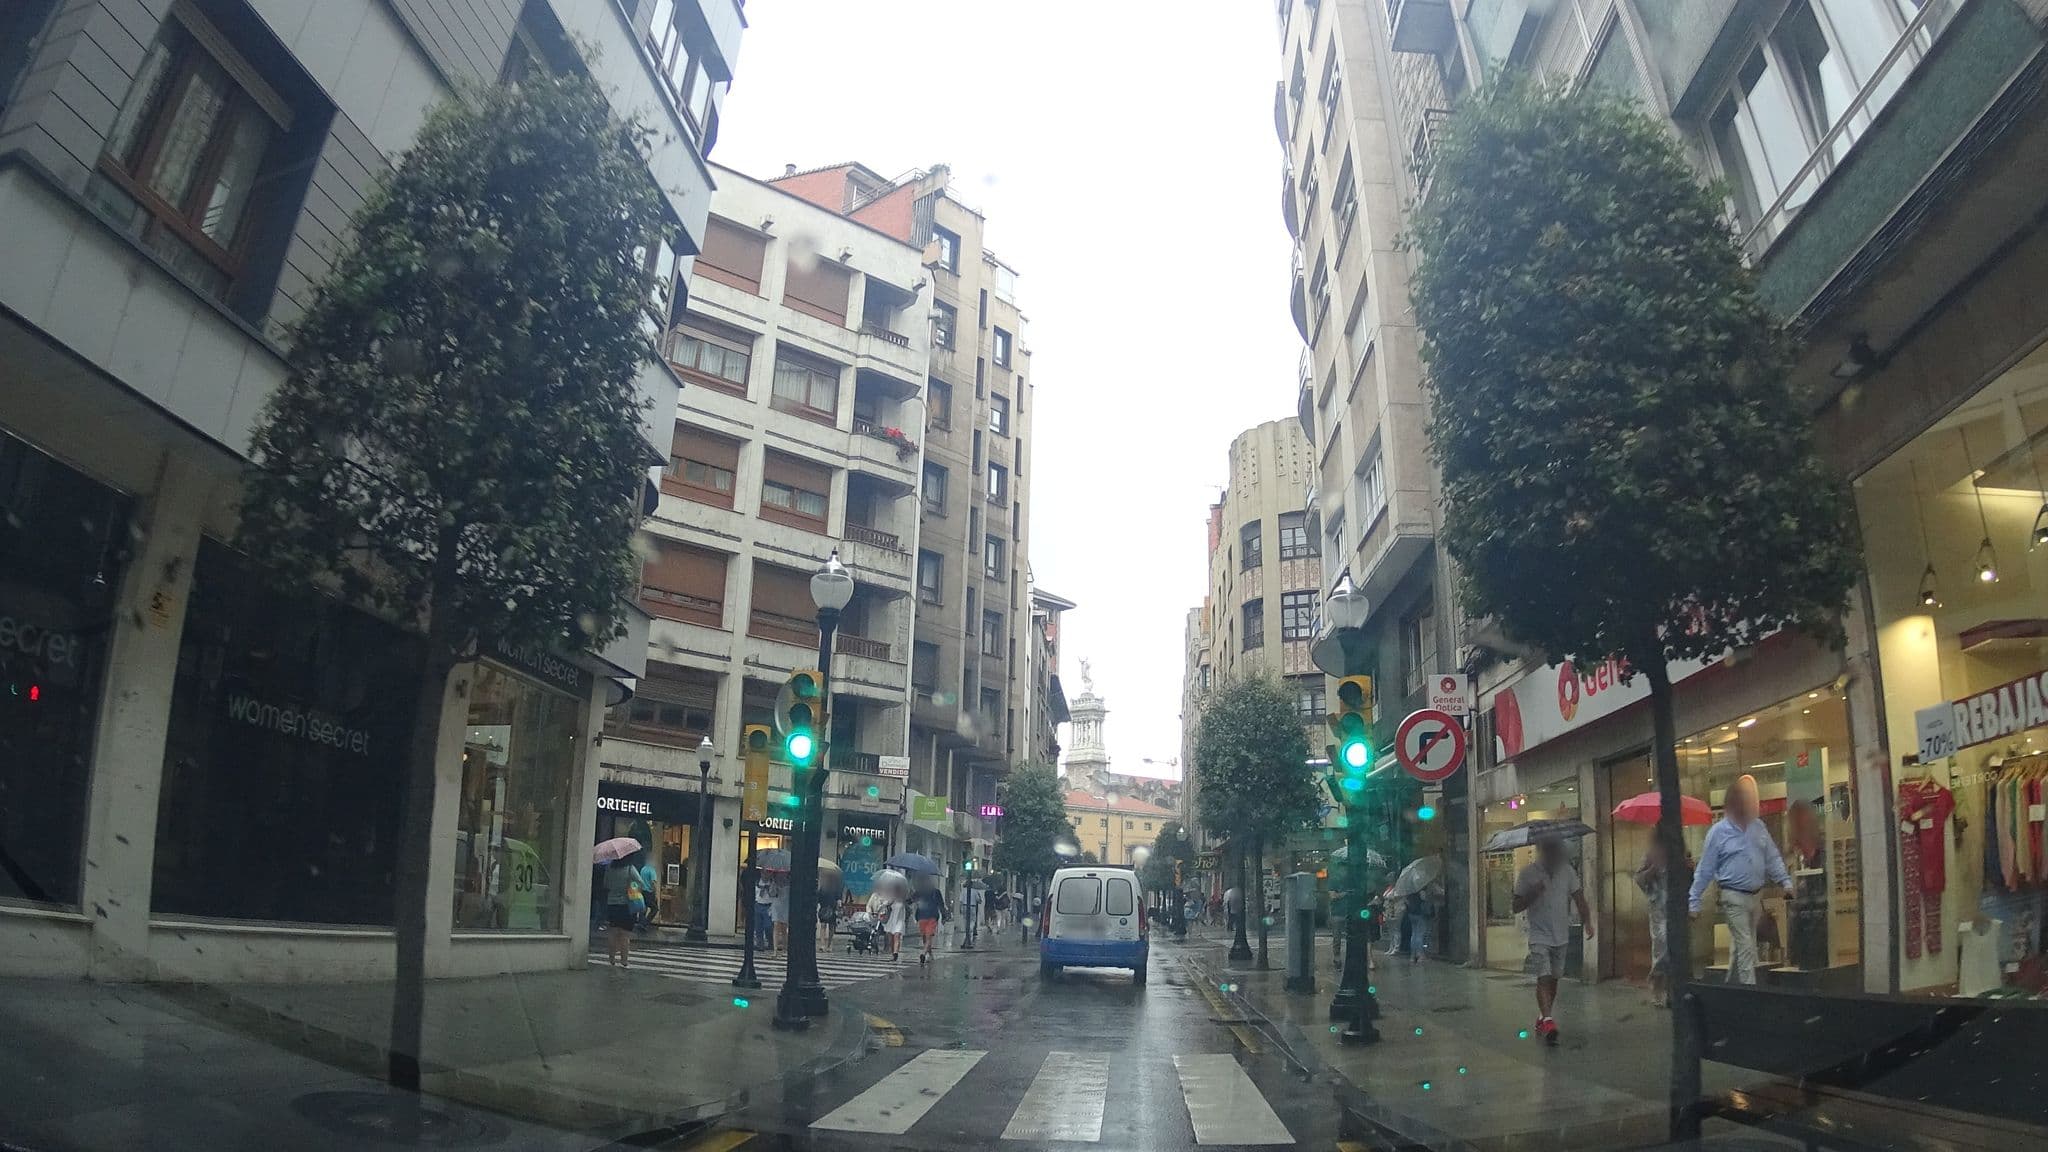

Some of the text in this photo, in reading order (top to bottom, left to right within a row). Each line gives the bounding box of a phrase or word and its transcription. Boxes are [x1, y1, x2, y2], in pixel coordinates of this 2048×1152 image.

[1433, 695, 1465, 704] General
[229, 693, 370, 756] women'secret
[844, 825, 886, 839] CORTEFIEL
